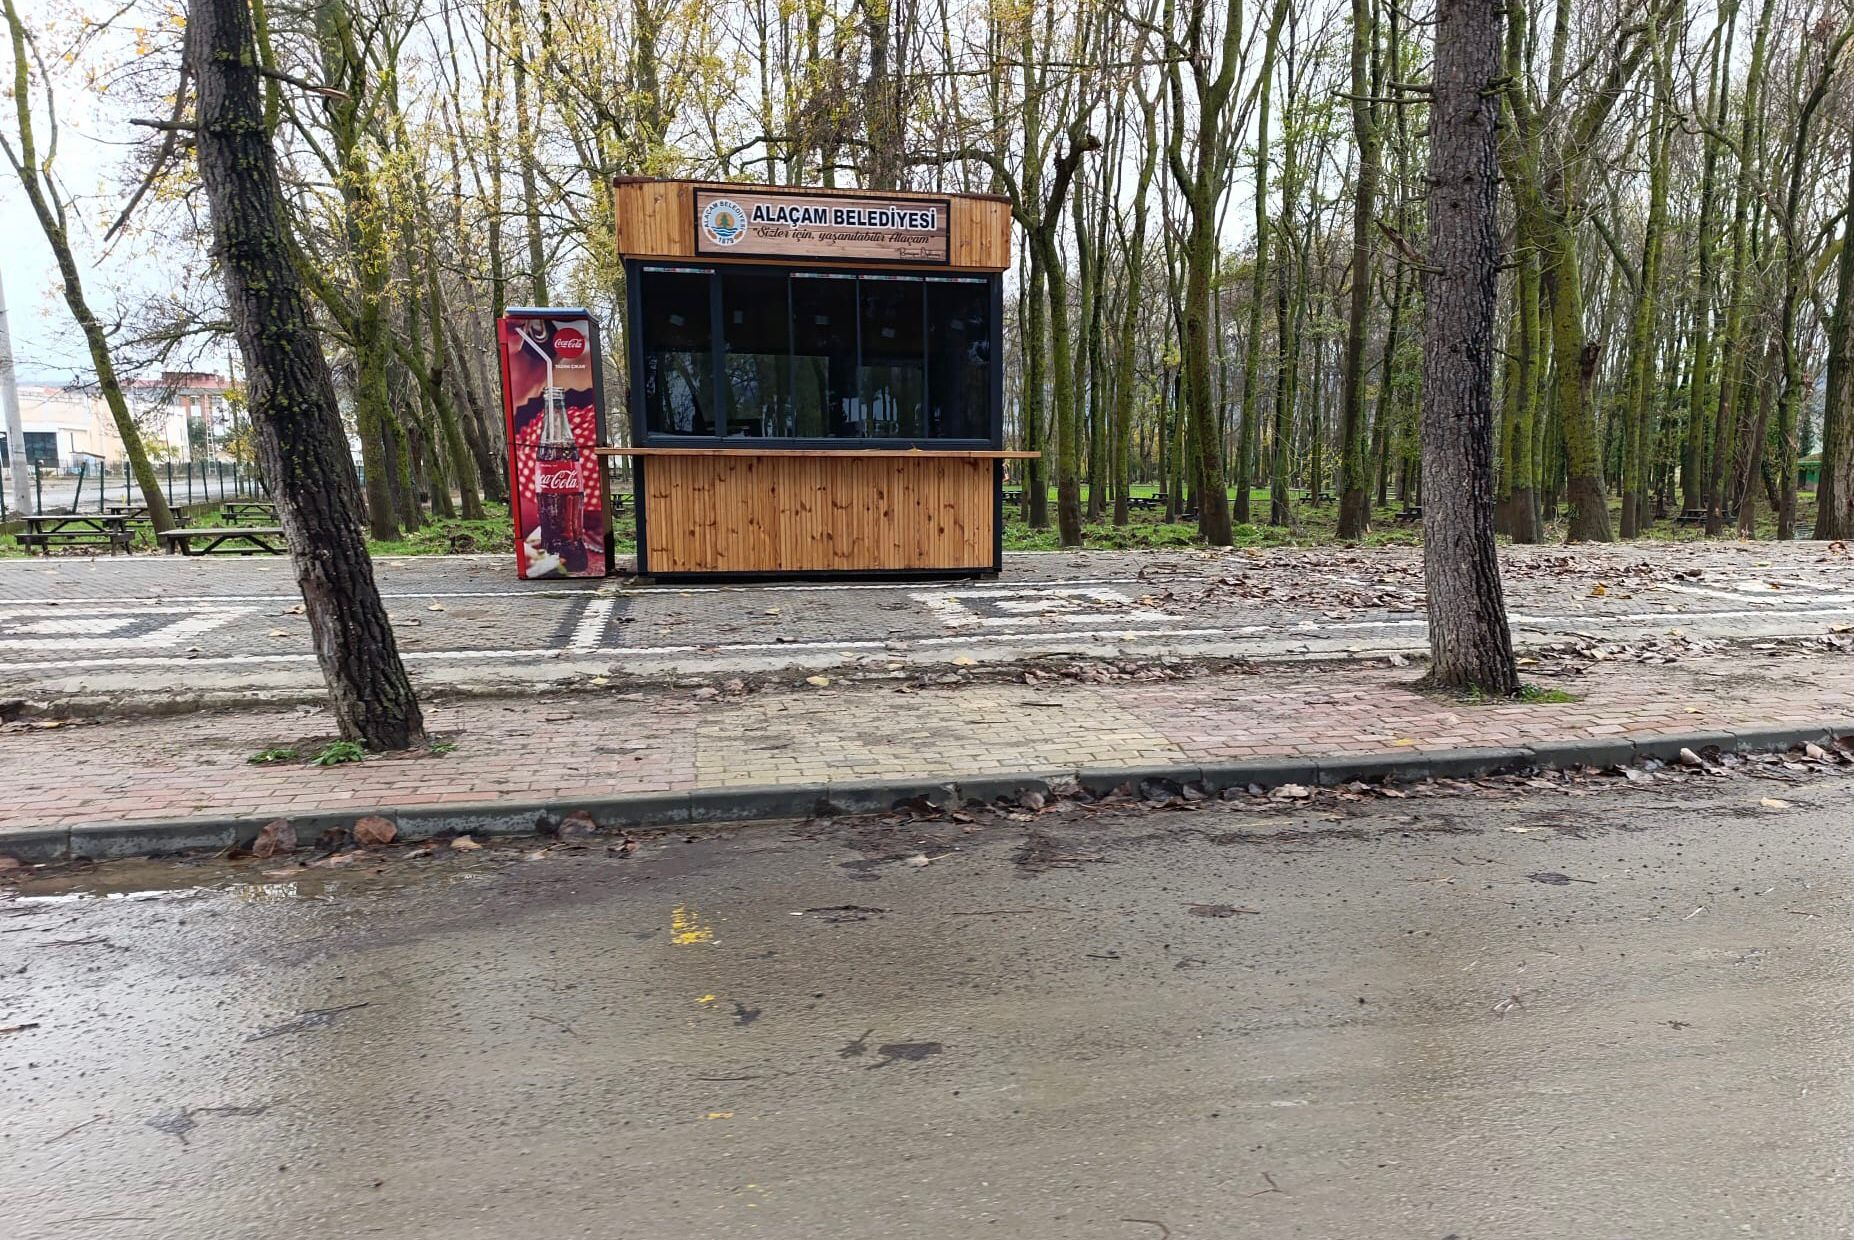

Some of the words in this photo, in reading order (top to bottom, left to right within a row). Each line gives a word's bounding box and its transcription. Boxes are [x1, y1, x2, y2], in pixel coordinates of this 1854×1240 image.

[753, 205, 828, 227] ALAÇAM
[834, 207, 936, 229] BELEDİYESİ
[554, 338, 582, 348] Coca-Cola
